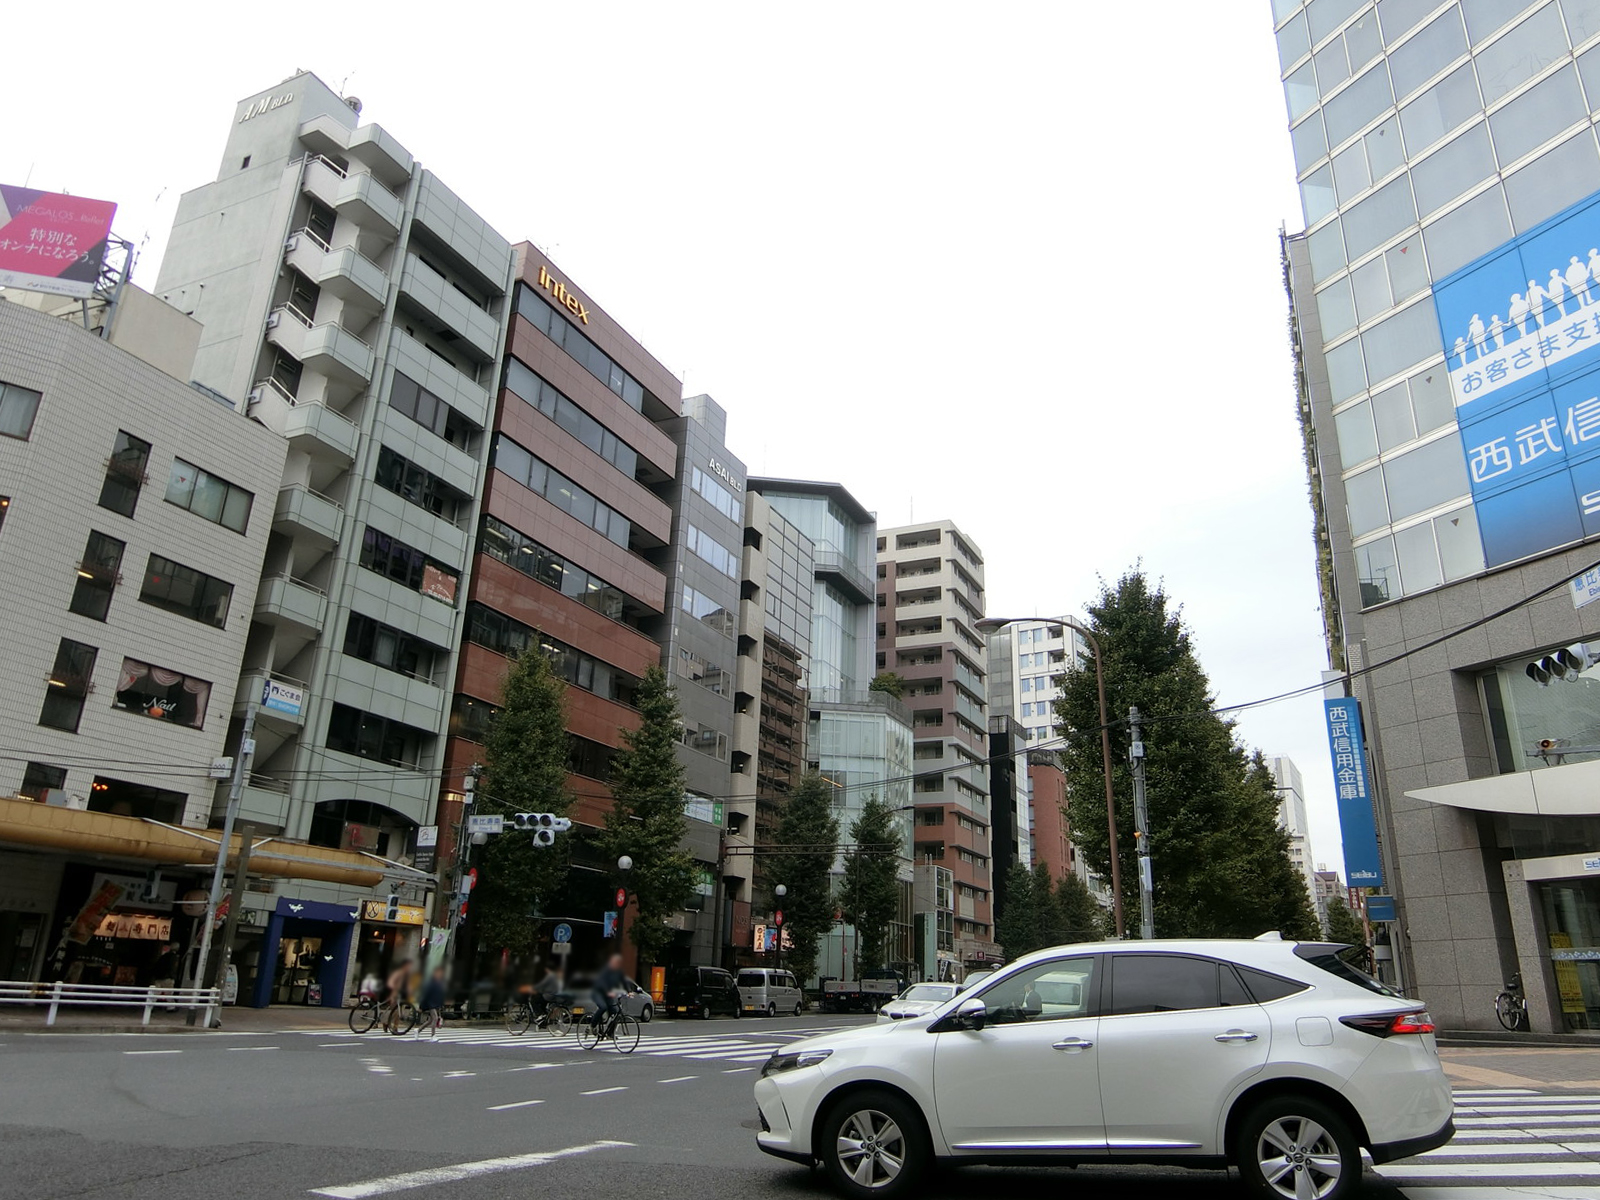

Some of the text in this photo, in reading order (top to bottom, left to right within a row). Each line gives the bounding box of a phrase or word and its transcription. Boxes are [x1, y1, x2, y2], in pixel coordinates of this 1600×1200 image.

[239, 96, 271, 123] AM
[16, 204, 75, 221] MEGALOS
[29, 228, 78, 246] 特別な
[538, 265, 590, 325] intex
[1462, 311, 1600, 395] お客さま支
[708, 457, 731, 482] ASAI
[1574, 566, 1600, 592] 恵比
[1329, 706, 1359, 801] 西武信用金庫
[557, 928, 566, 942] P
